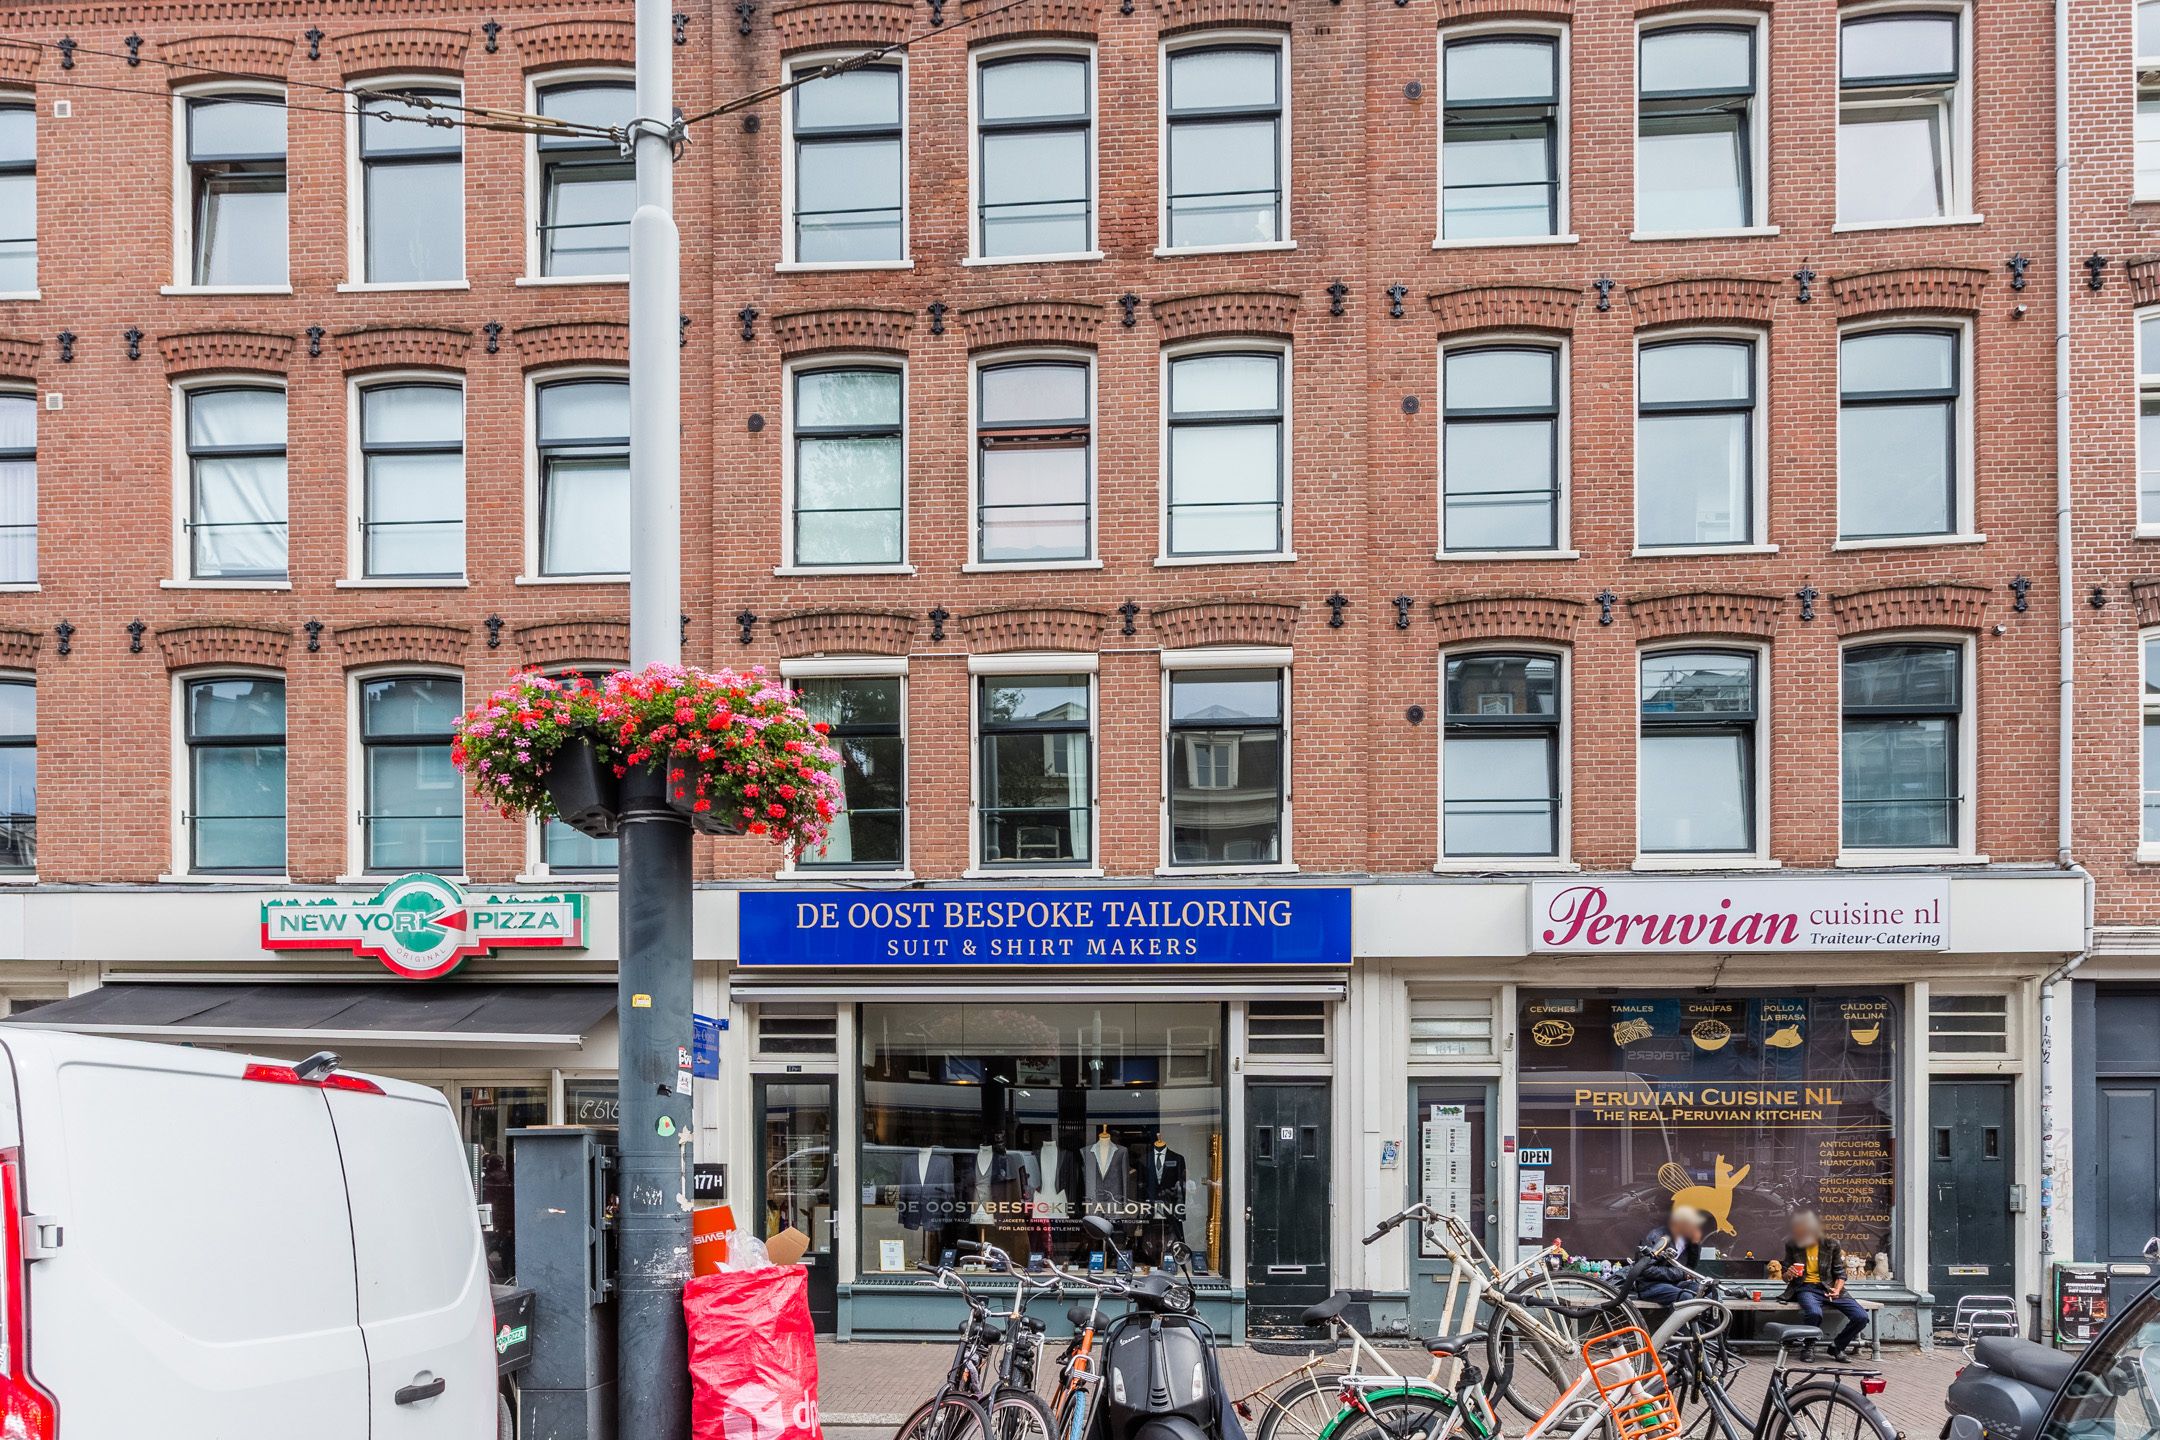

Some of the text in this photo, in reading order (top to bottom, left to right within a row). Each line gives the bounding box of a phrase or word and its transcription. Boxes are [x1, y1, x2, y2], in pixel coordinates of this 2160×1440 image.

[280, 909, 560, 935] NEW YORK PIZZA
[796, 900, 1292, 929] DE OOST BESPOKE TAILORING
[1543, 885, 1940, 945] Peruvian cuisine nl
[1810, 932, 1941, 947] Traiteur-Catering
[396, 947, 447, 963] ORIGINAL
[887, 938, 1198, 957] SUIT & SHIRT MAKERS
[1763, 1004, 1803, 1012] POLLO A
[1840, 1003, 1874, 1011] CALDO
[1804, 1087, 1842, 1105] NL
[1521, 1150, 1550, 1163] OPEN
[896, 1201, 1186, 1215] DE OOST BESPOKE TAILORING
[1820, 1214, 1890, 1222] OMO SALTADO
